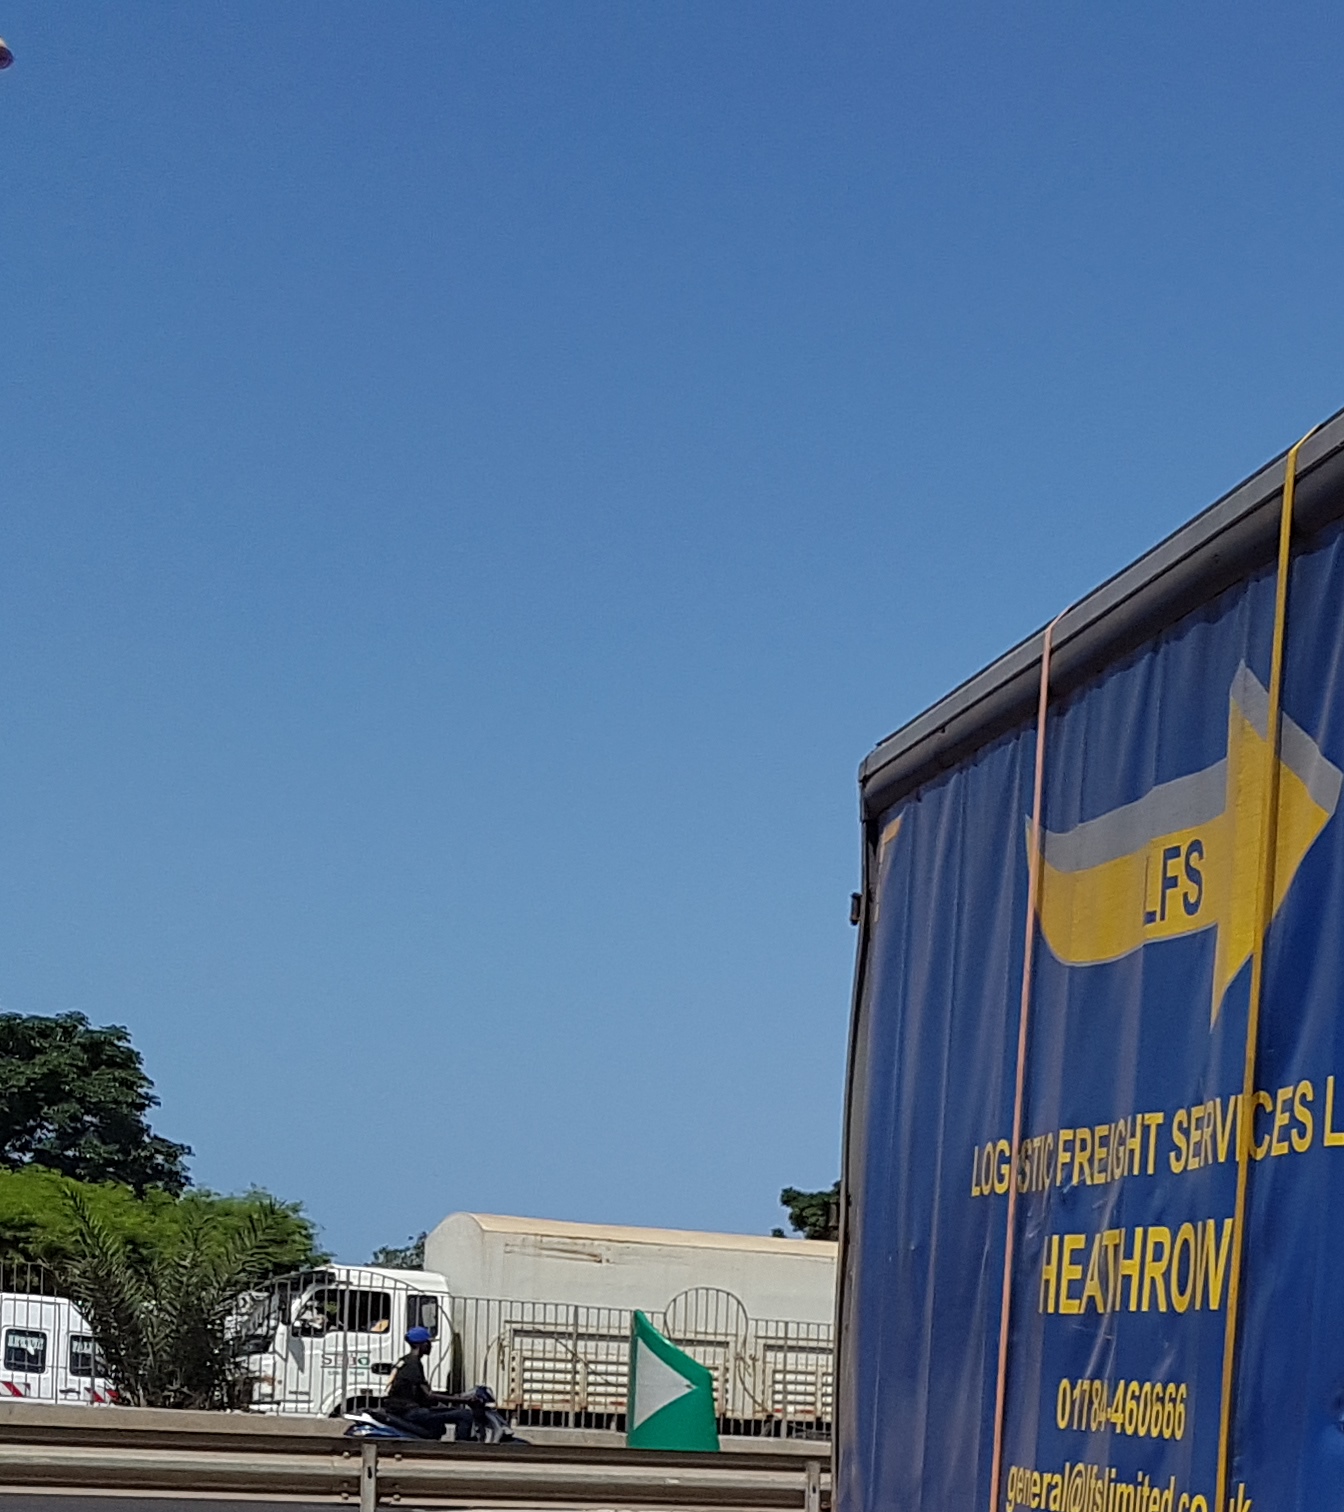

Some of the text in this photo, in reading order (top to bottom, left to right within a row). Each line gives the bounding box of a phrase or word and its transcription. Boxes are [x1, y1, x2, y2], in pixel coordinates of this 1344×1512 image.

[971, 1132, 1054, 1197] LOGSTIC
[1055, 1111, 1164, 1187] FREIGHT
[1169, 1079, 1315, 1174] SERVICES
[1039, 1218, 1235, 1314] HEATHROW
